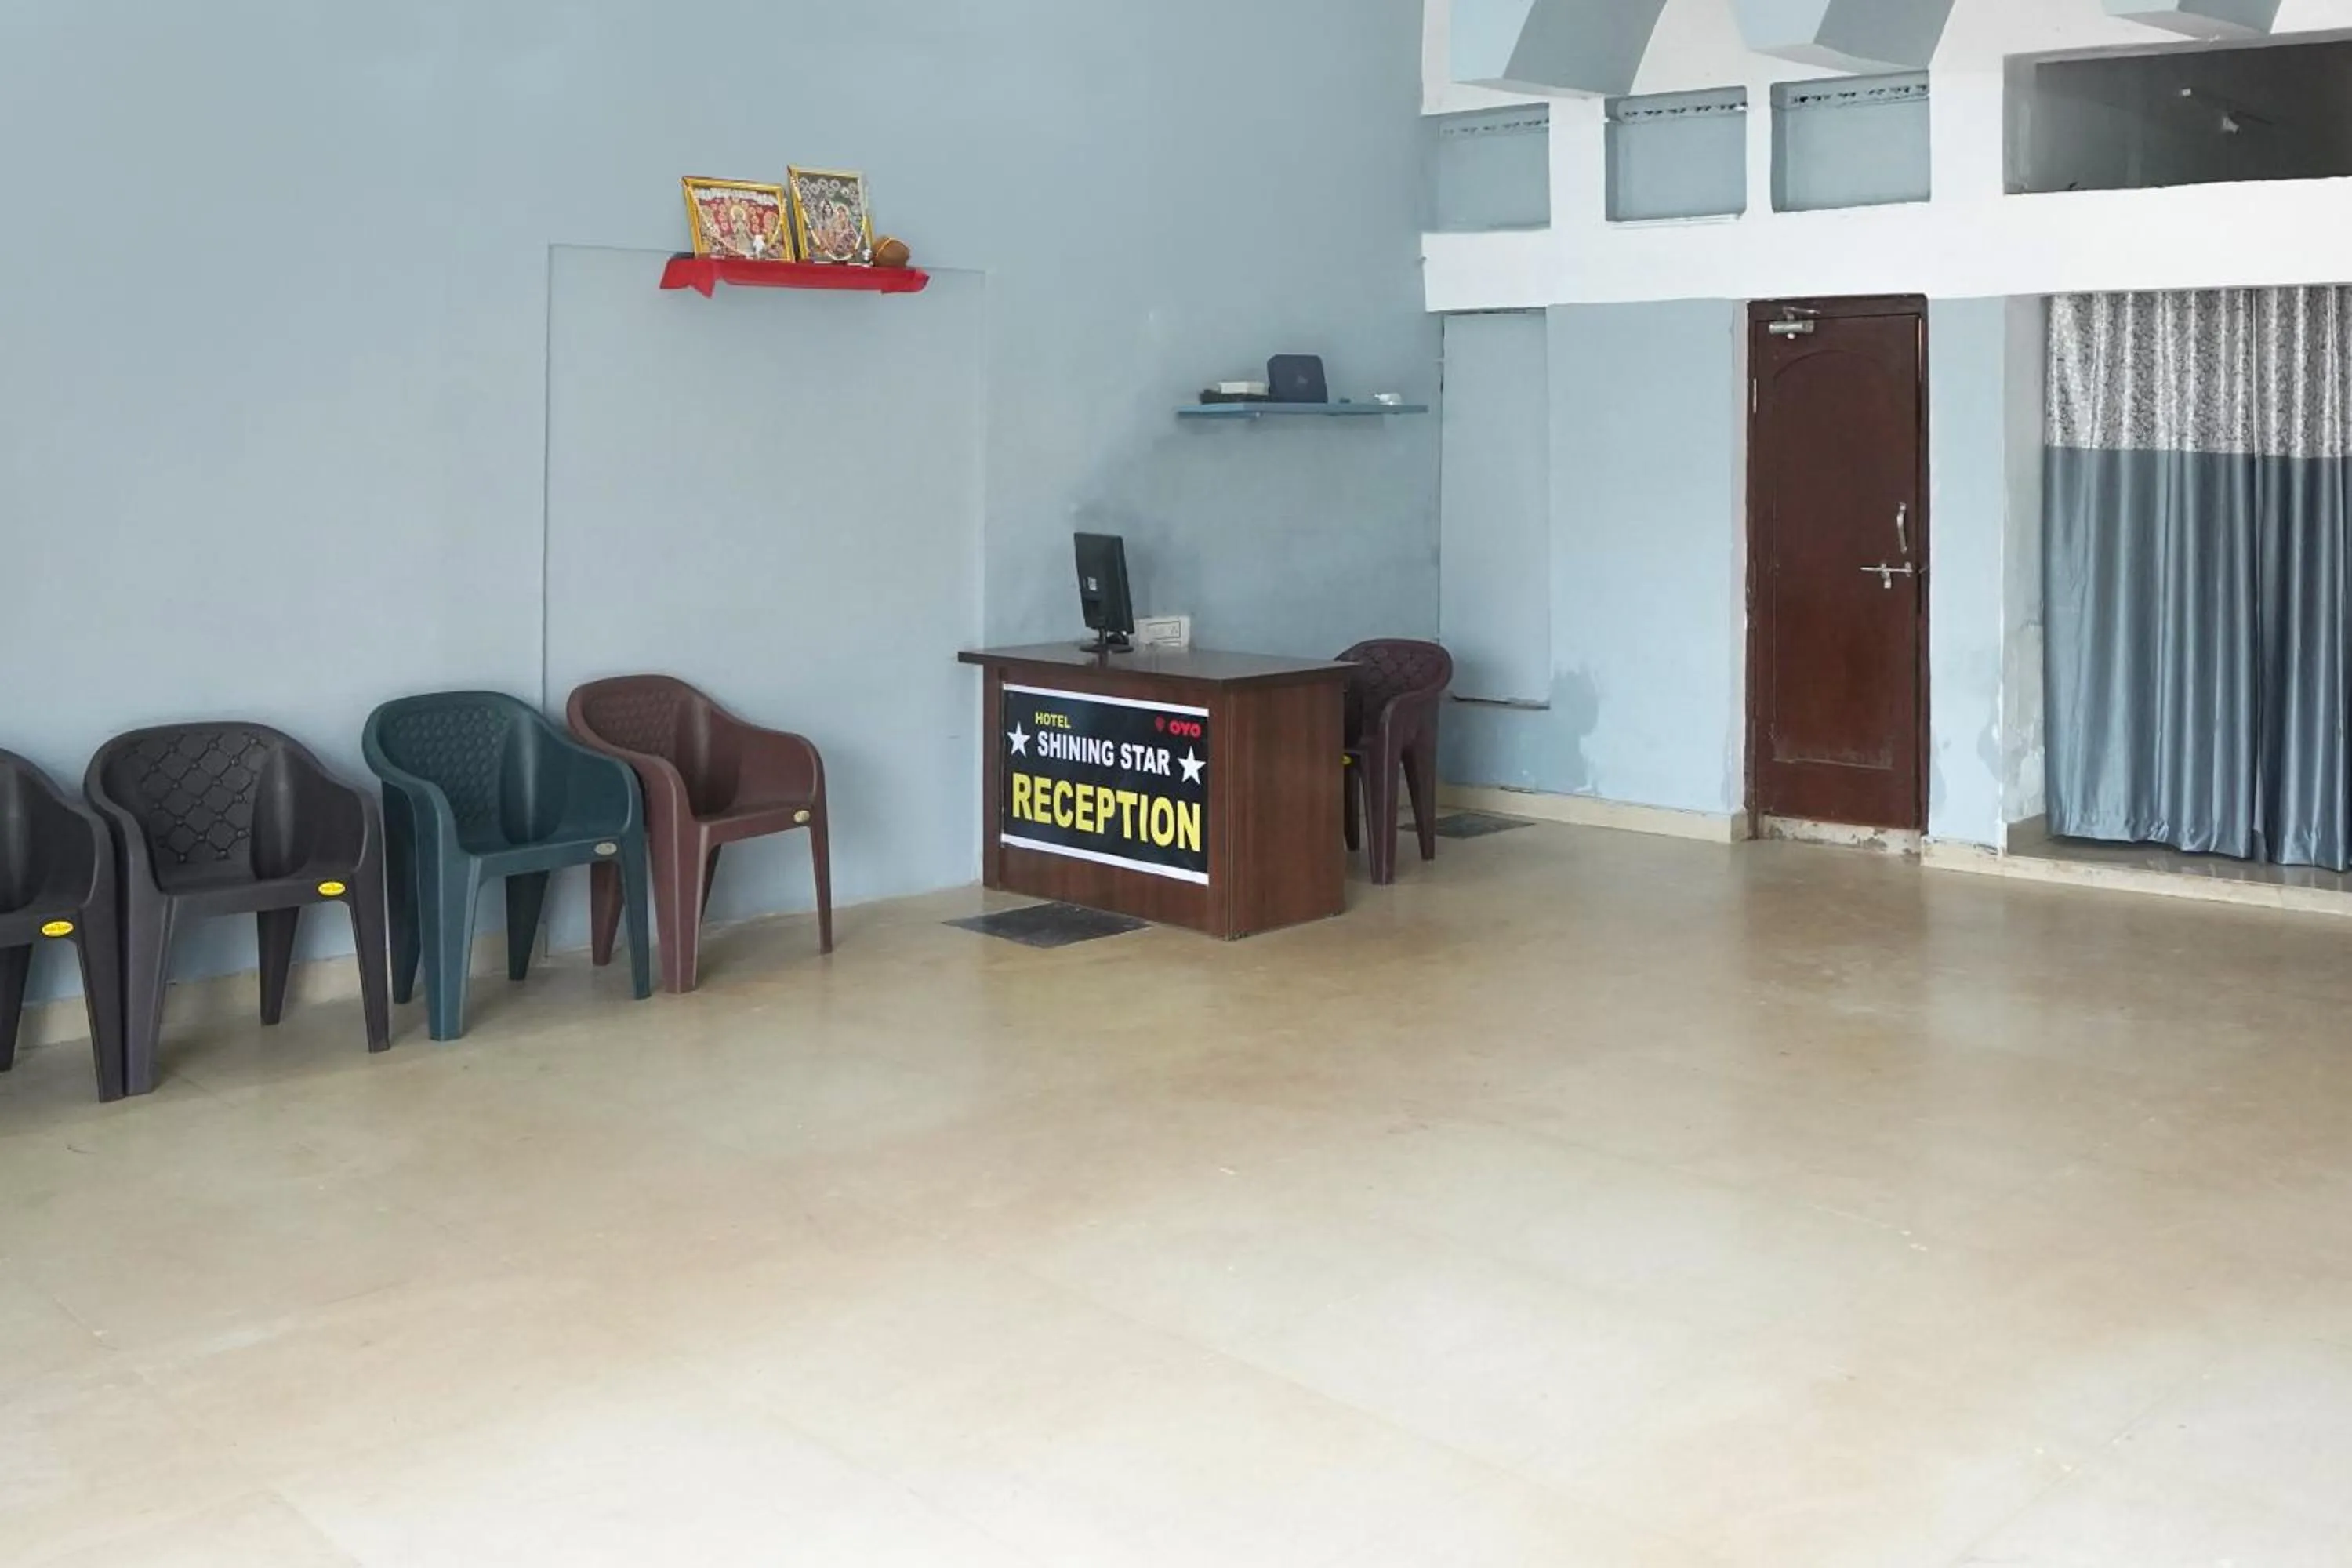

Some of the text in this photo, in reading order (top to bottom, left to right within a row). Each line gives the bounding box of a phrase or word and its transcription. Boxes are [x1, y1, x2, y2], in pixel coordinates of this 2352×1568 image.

[1035, 711, 1072, 729] HOTEL
[1169, 720, 1202, 739] OYO
[1037, 730, 1171, 776] SHINING STAR
[1011, 772, 1201, 853] RECEPTION
